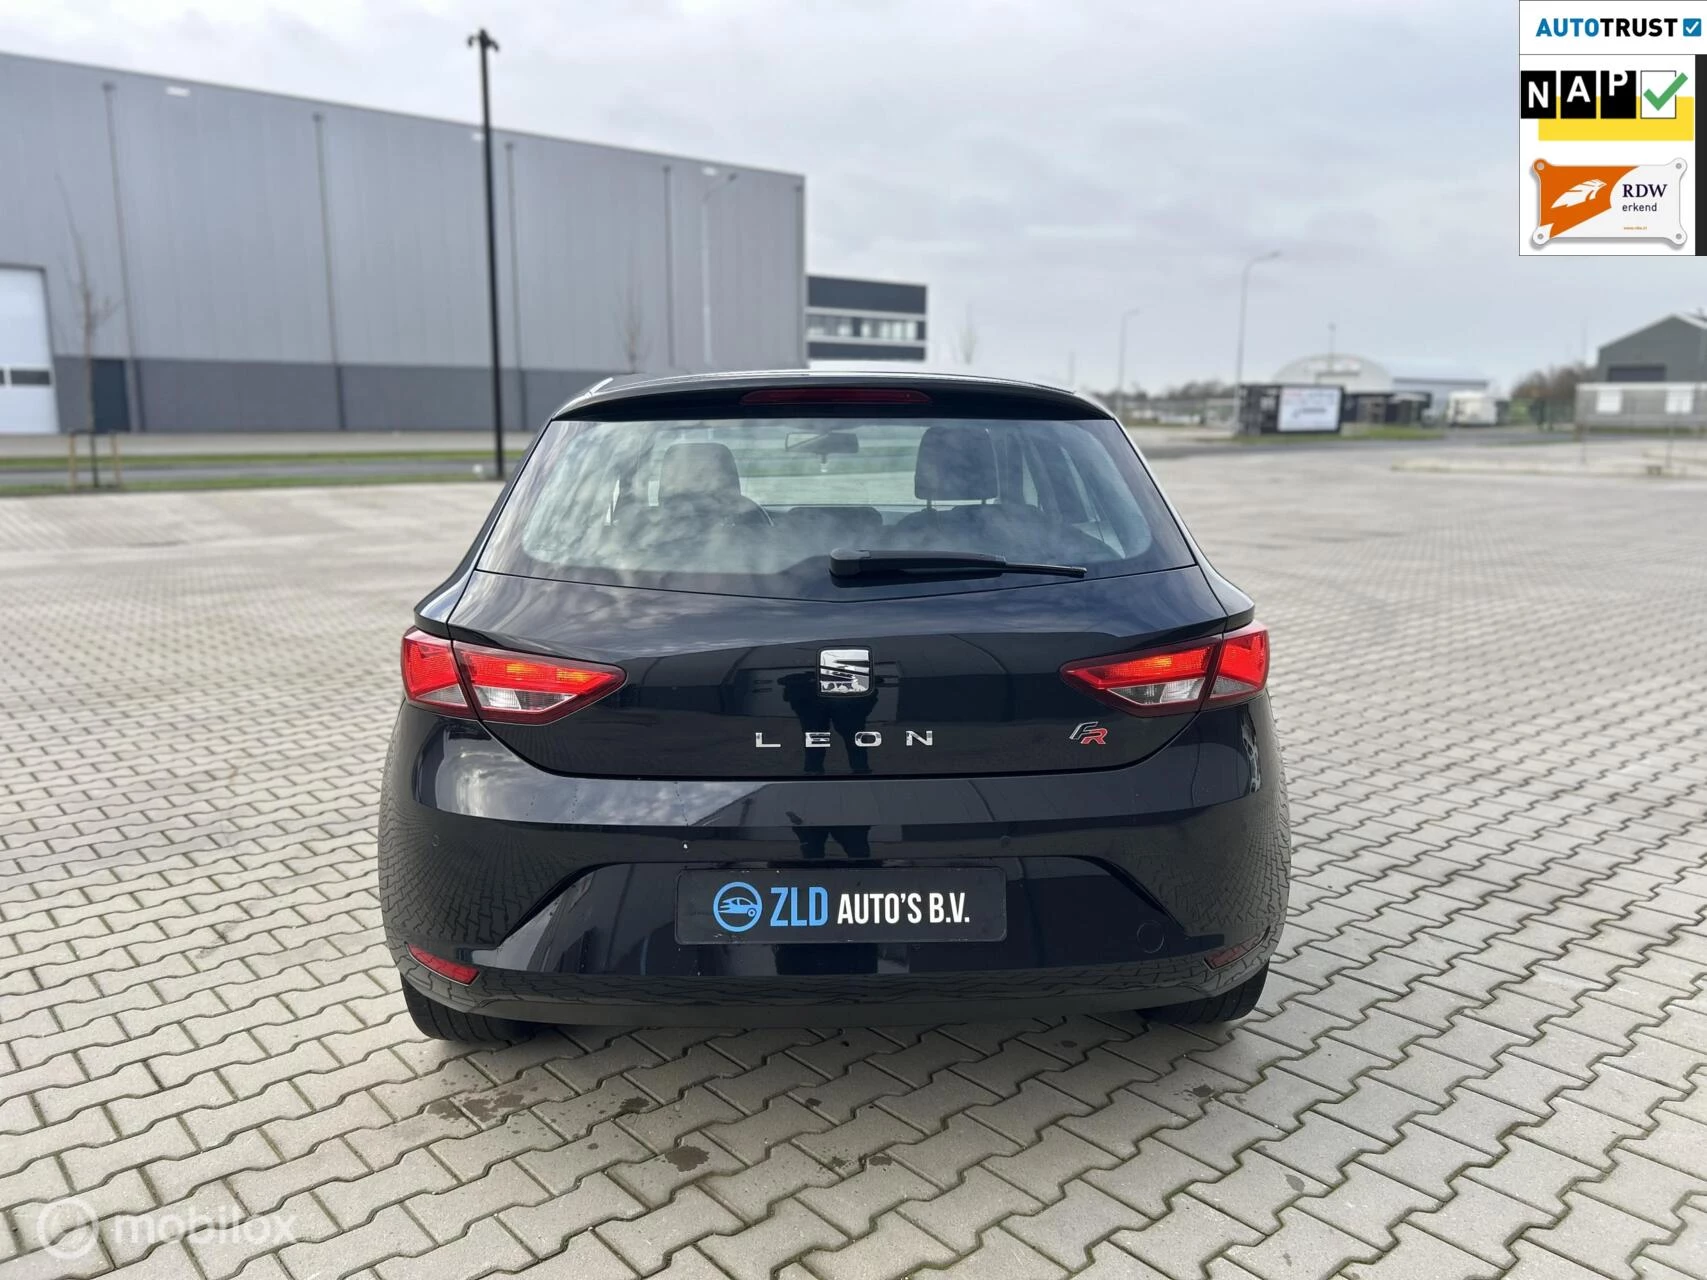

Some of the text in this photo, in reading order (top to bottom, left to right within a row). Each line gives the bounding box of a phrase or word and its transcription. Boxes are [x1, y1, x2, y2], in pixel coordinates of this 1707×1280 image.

[755, 730, 933, 748] LEON
[1069, 721, 1108, 745] FR
[769, 886, 970, 927] ZLD AUTO'S B.V.
